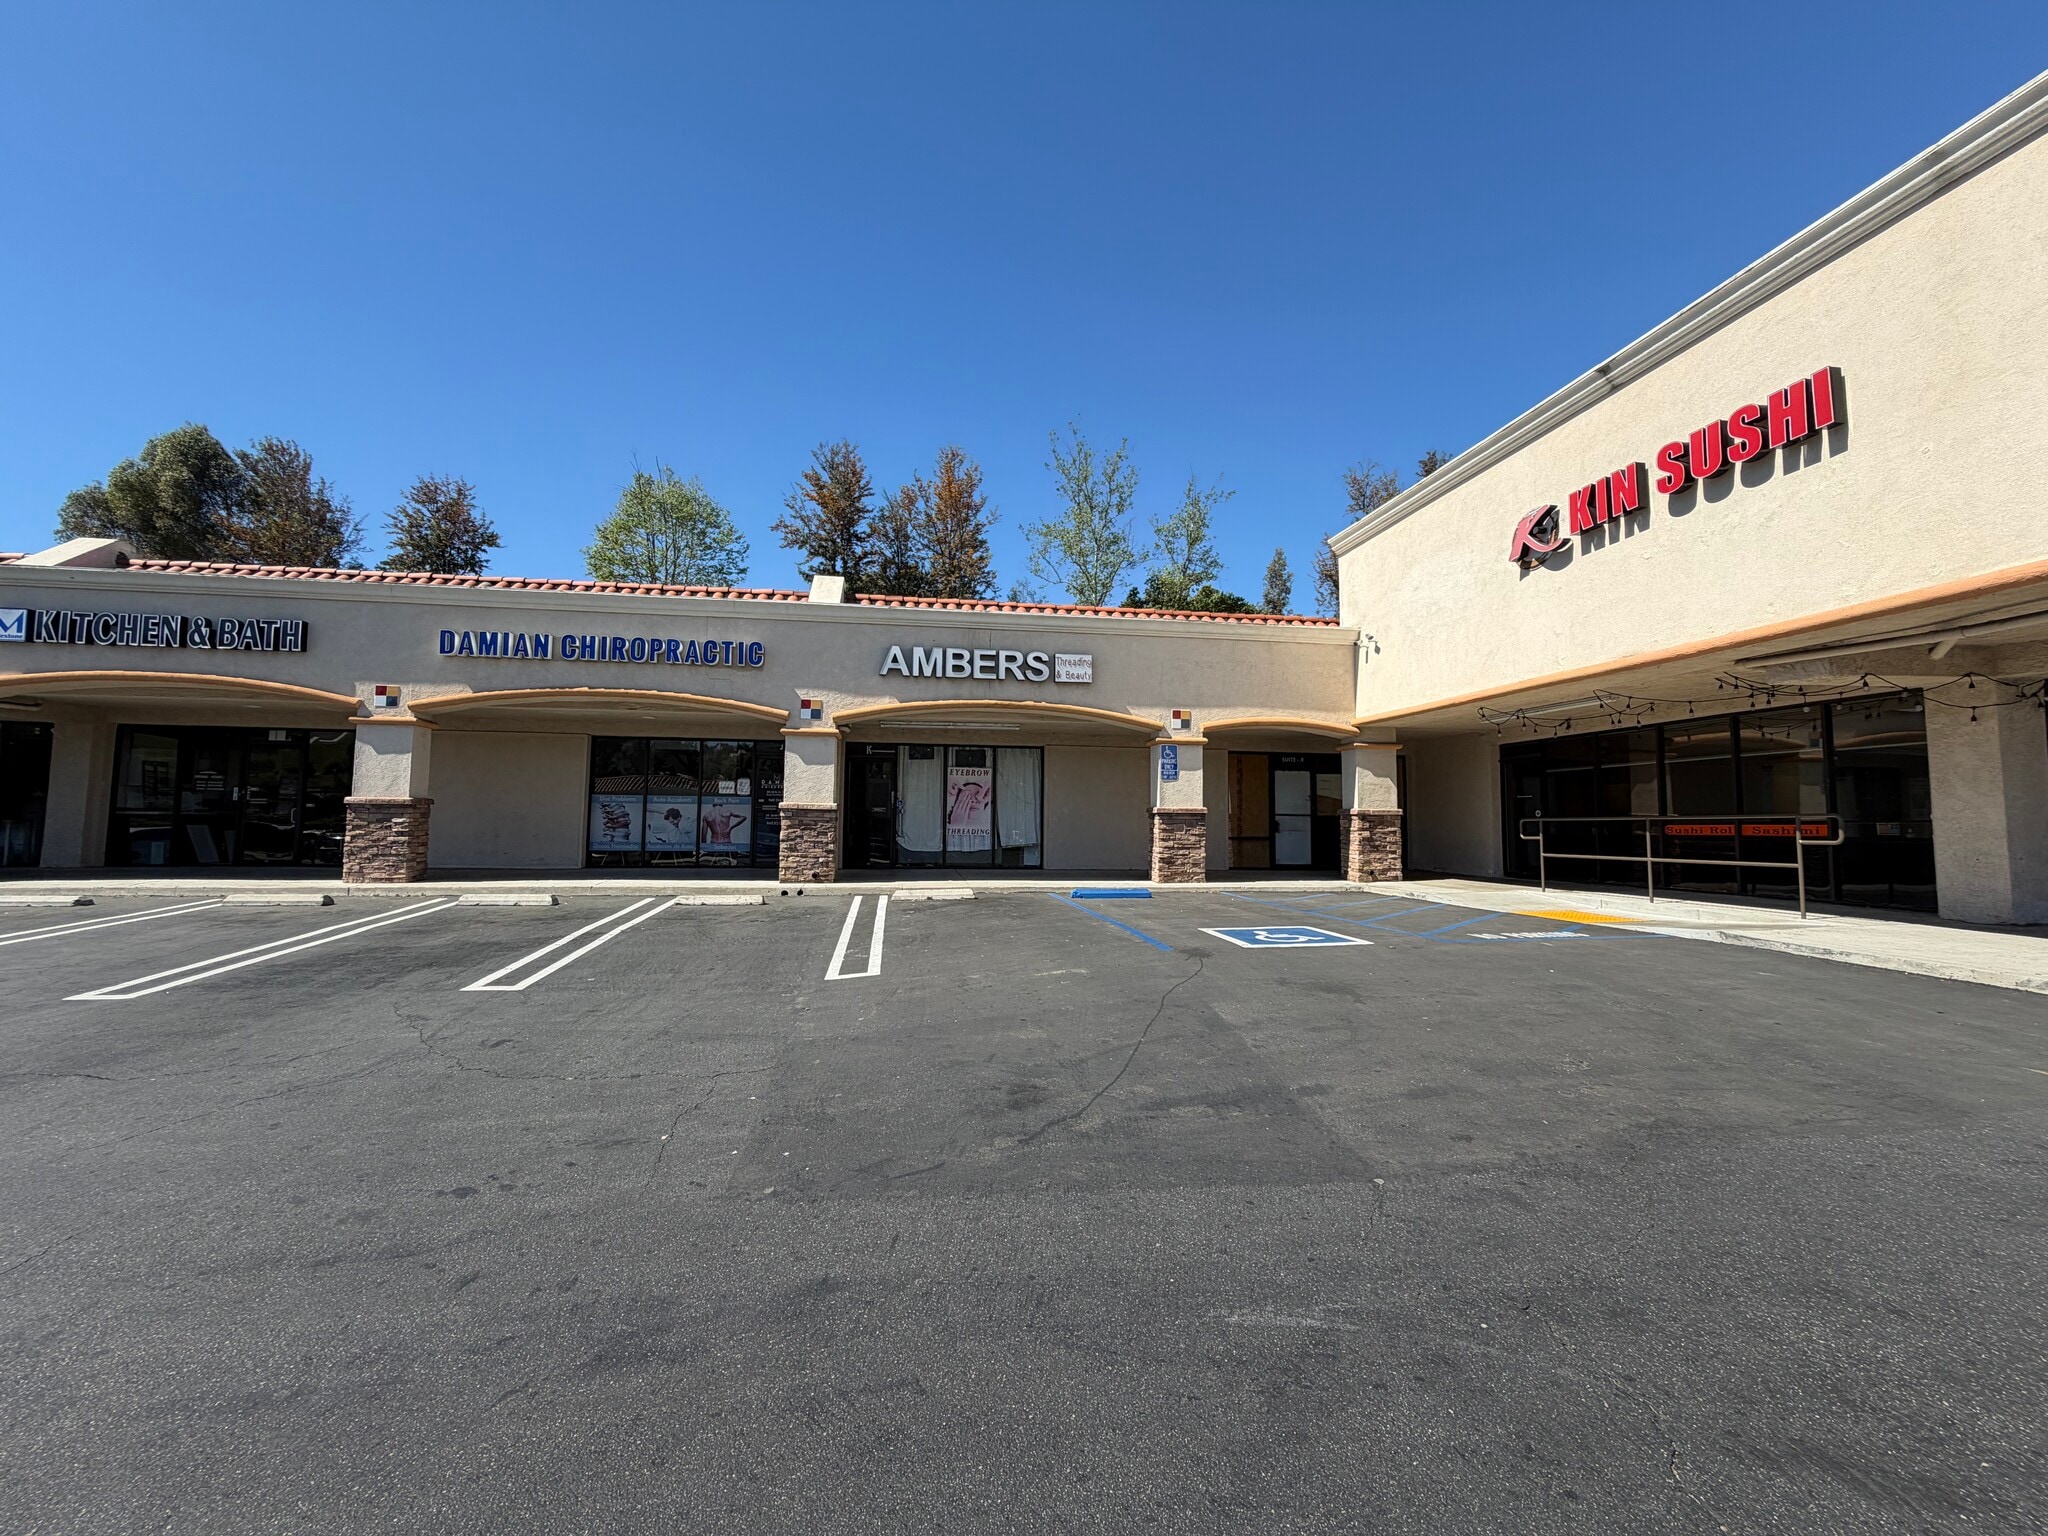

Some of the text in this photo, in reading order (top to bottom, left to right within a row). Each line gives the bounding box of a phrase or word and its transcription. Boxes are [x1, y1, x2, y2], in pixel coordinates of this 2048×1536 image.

[1568, 366, 1838, 536] KIN SUSHI
[33, 609, 302, 652] KITCHEN & BATH
[439, 629, 765, 668] DAMIAN CHIROPRACTIC
[879, 645, 1050, 683] AMBERS
[1055, 656, 1092, 668] Threading
[1056, 670, 1092, 682] & Beauty
[866, 745, 873, 755] K
[949, 768, 991, 777] EYEBROW
[946, 827, 991, 836] THREADING
[1666, 826, 1703, 834] Sushi
[1752, 826, 1820, 835] Sashimi
